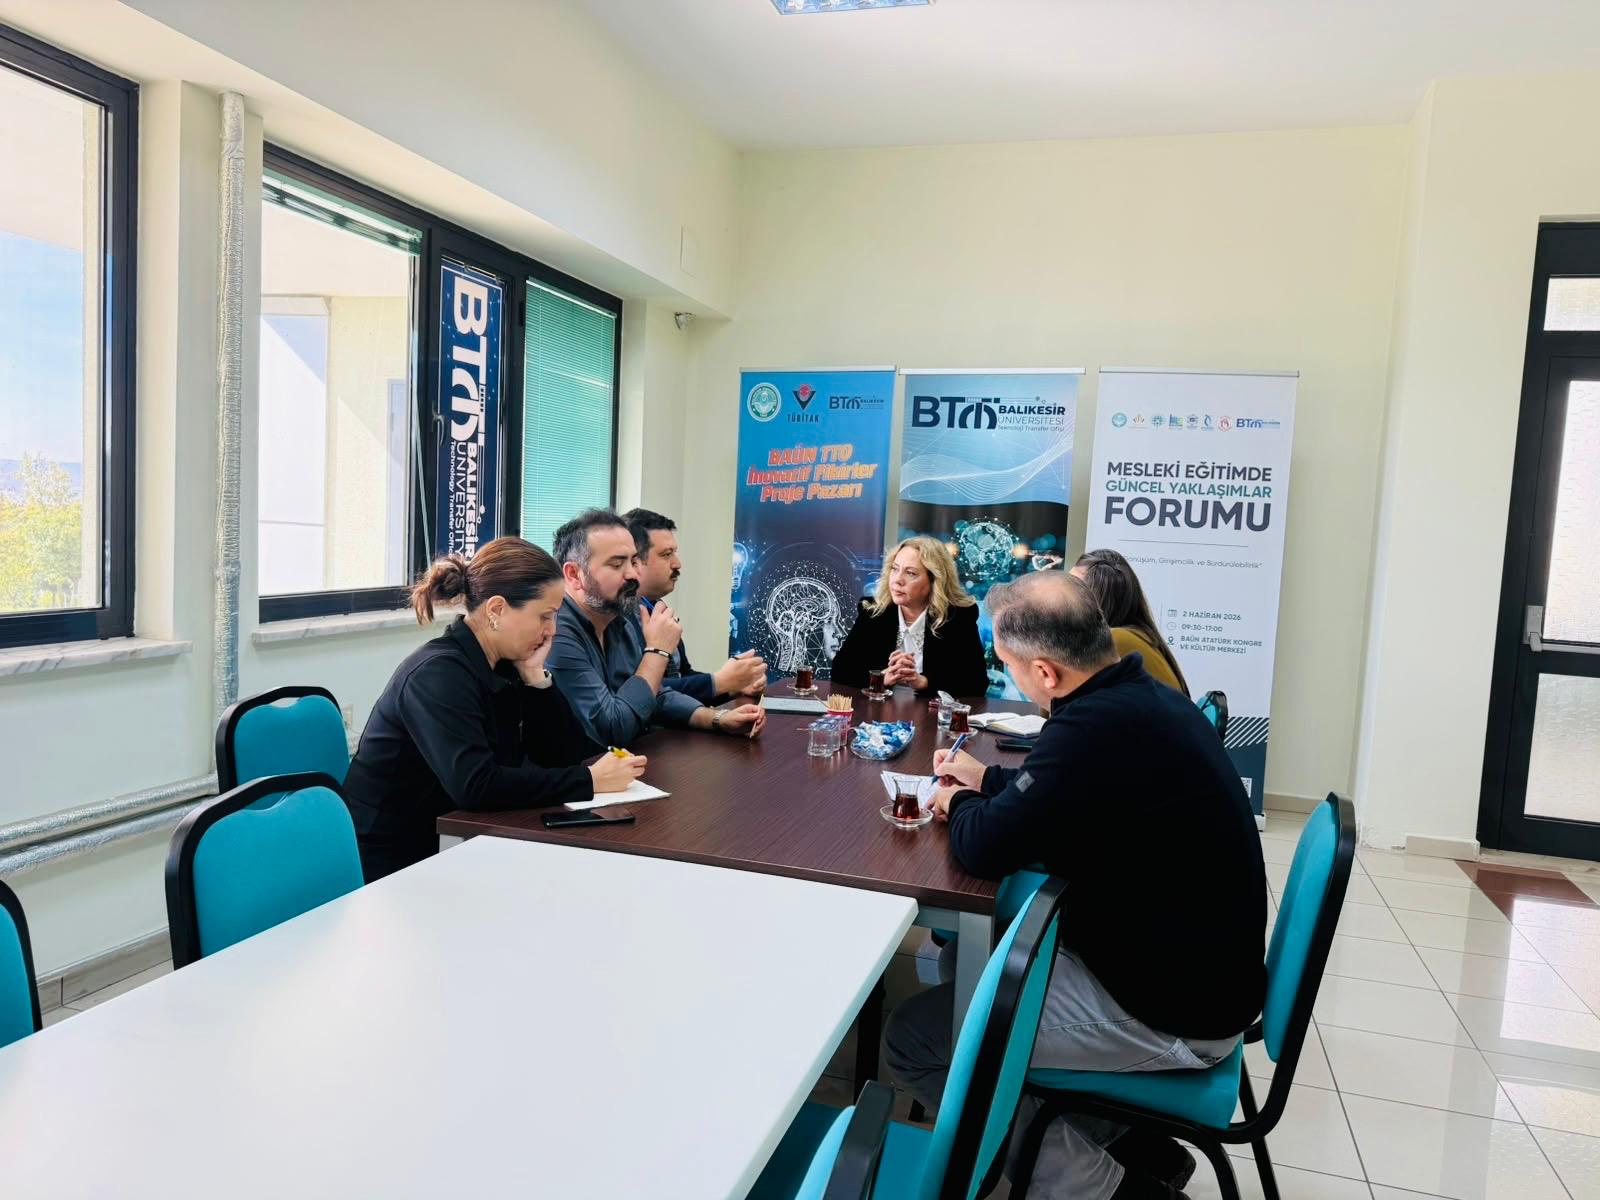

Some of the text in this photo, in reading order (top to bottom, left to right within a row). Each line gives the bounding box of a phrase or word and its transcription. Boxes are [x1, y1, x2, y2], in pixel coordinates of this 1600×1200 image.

[787, 411, 819, 423] TÜBİTAK
[998, 403, 1066, 415] BALIKESİR
[768, 443, 854, 466] BAÜN TTO
[448, 441, 456, 492] Technology
[1107, 460, 1272, 482] MESLEKİ EĞİTİMDE
[760, 484, 805, 504] Proje
[1105, 478, 1272, 499] GÜNCEL YAKLAŞIMLAR
[454, 442, 466, 558] UNIVERSITY
[448, 495, 456, 530] Transfer
[1104, 496, 1272, 532] FORUMU
[1189, 611, 1221, 619] HAZİRAN
[1223, 613, 1241, 621] 2026
[1181, 624, 1223, 632] 09:30-17:00
[1190, 643, 1215, 652] KÜLTÜR
[1217, 646, 1247, 654] MERKEZİ
[1201, 636, 1231, 645] ATATÜRK
[1233, 639, 1262, 647] KONGRE
